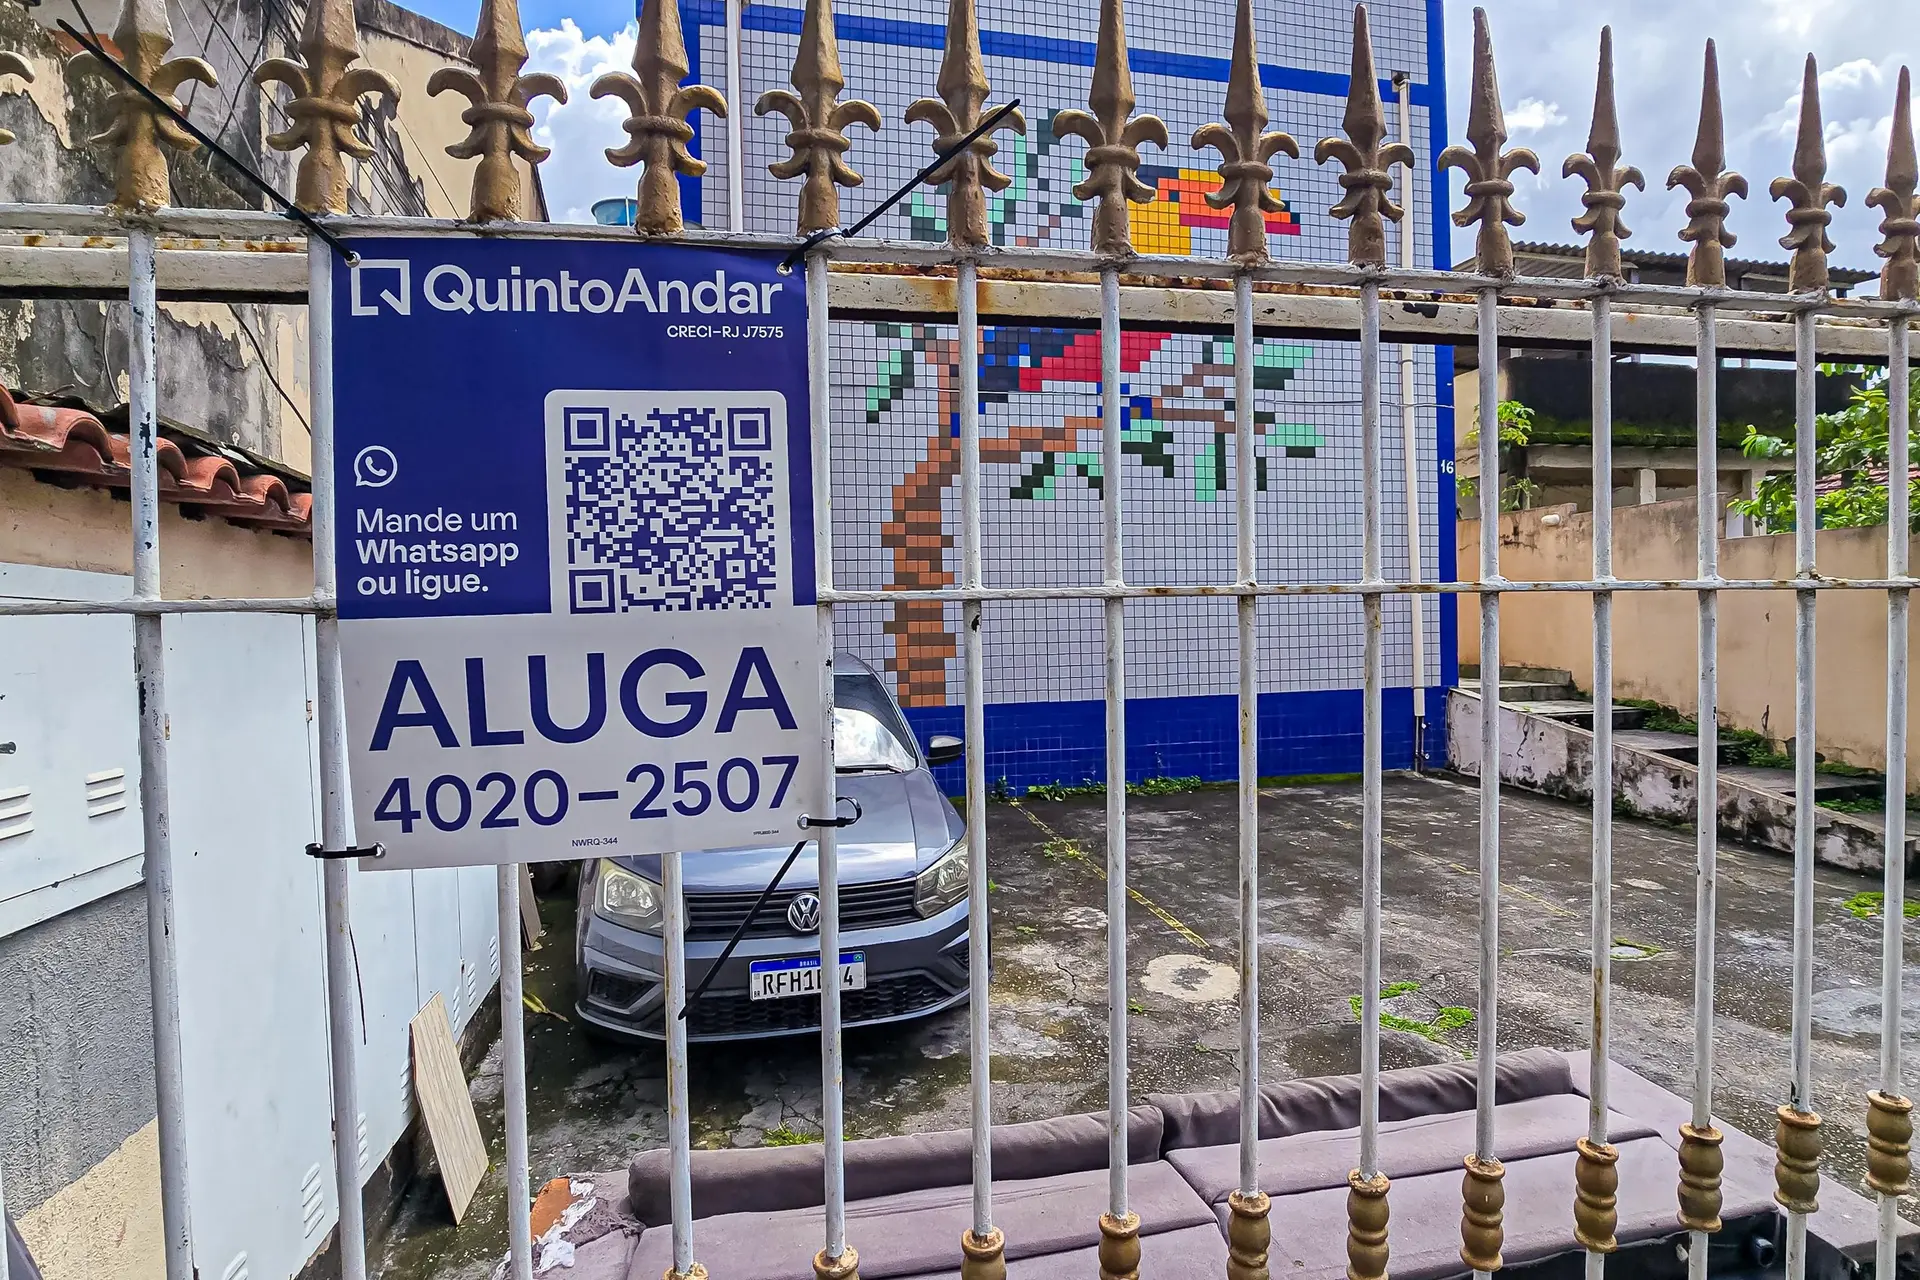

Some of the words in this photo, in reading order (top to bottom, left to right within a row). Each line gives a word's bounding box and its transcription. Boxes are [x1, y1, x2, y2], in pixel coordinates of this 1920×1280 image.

[423, 264, 783, 315] QuintoAndar
[666, 325, 740, 338] CRECI-RJ
[742, 325, 784, 338] J7575
[1440, 459, 1454, 474] 16
[356, 507, 463, 533] Mande
[471, 512, 518, 531] um
[355, 538, 519, 567] Whatsapp
[357, 576, 397, 595] ou
[405, 568, 489, 600] ligue.
[368, 646, 798, 751] ALUGA
[373, 755, 800, 834] 4020-2507
[571, 837, 618, 847] NWRQ-344
[763, 965, 854, 995] RFH14
